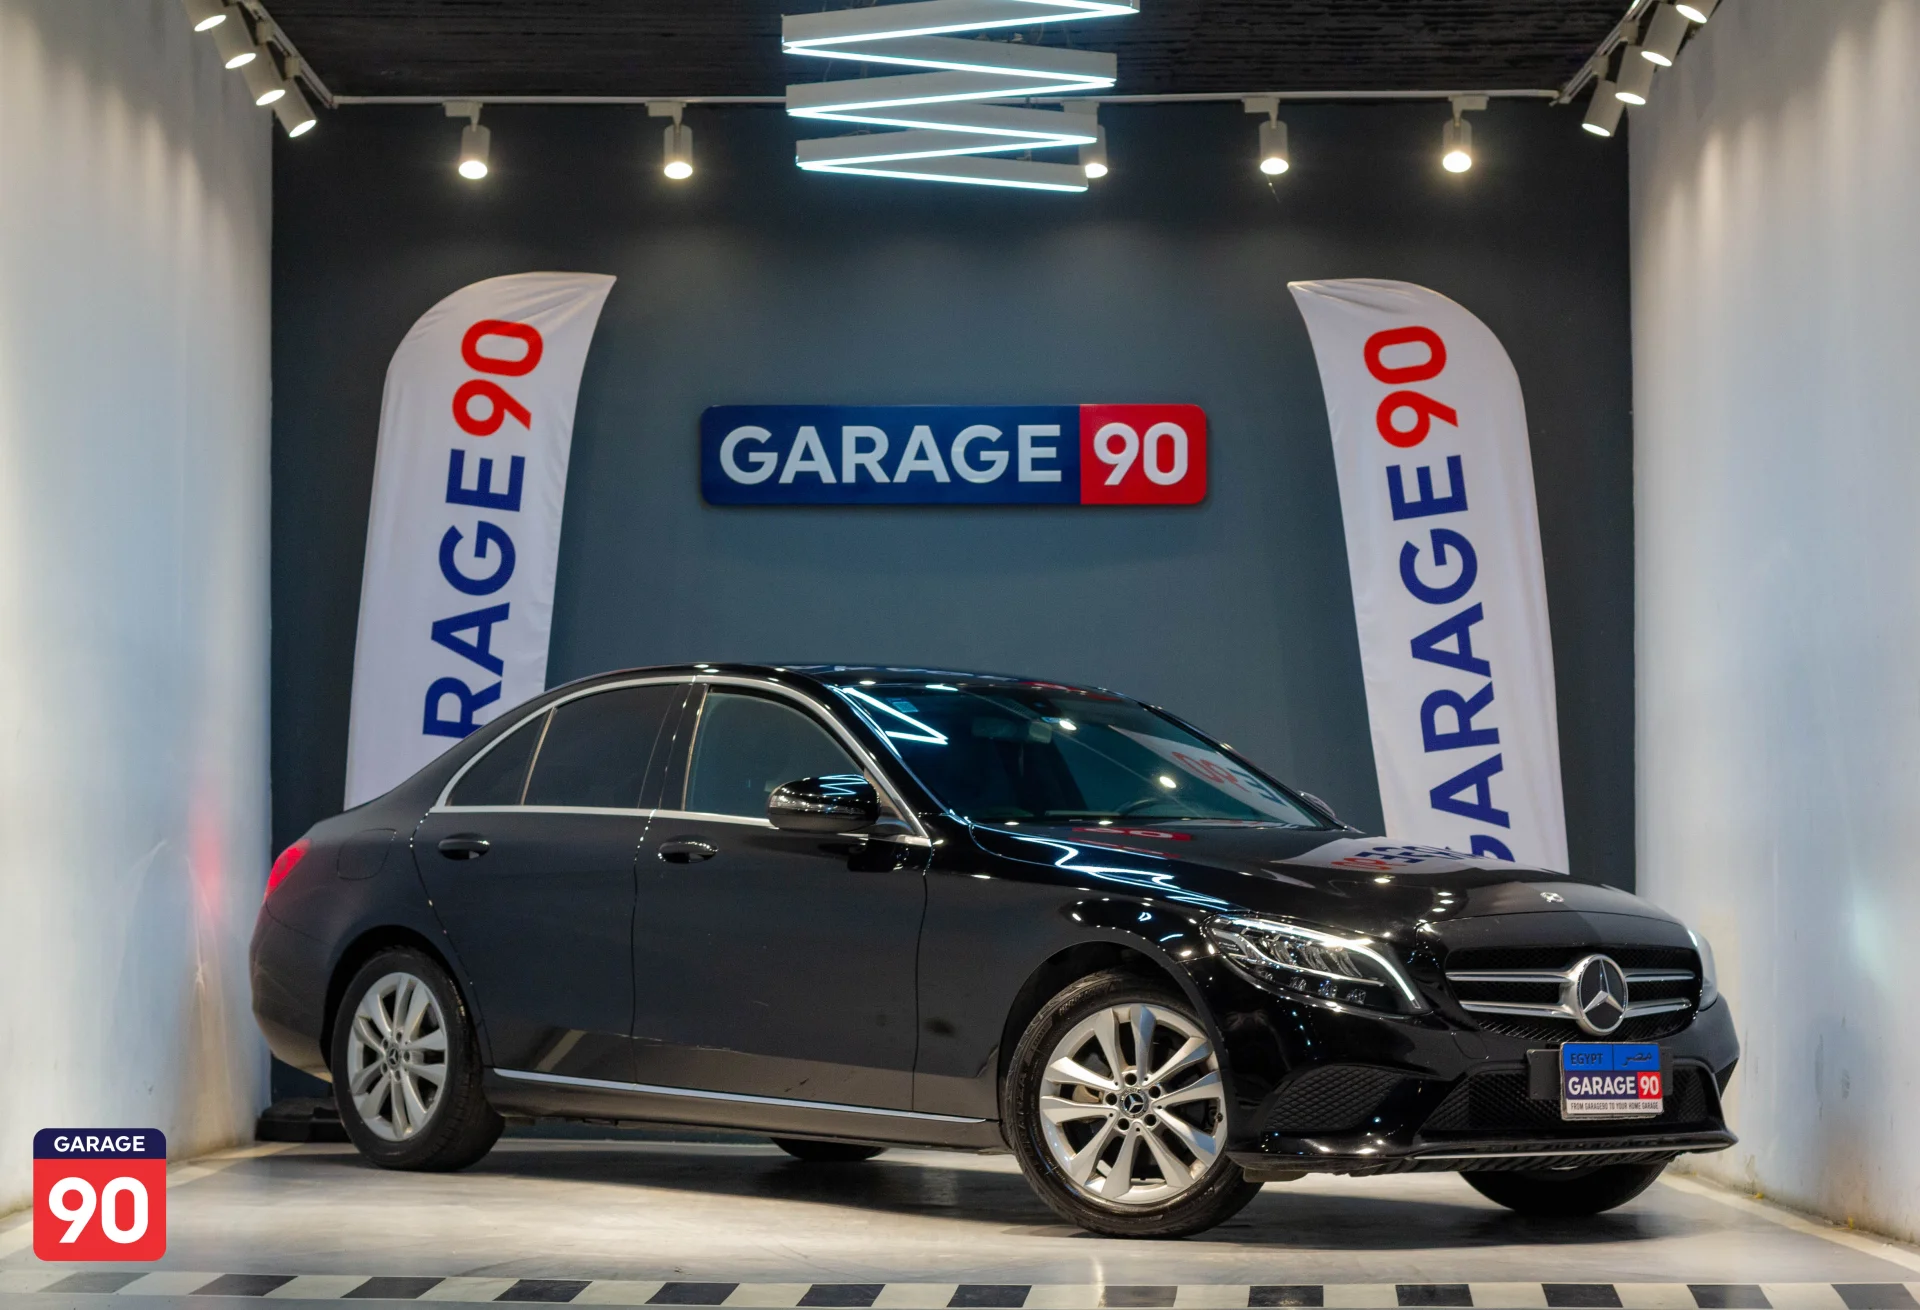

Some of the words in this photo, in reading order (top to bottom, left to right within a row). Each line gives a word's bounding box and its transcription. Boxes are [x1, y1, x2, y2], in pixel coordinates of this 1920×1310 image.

[719, 424, 1063, 485] GARAGE
[1093, 421, 1189, 487] 90
[1570, 1053, 1603, 1066] EGYPT
[1568, 1076, 1637, 1096] GARAGE
[1640, 1075, 1660, 1096] 90
[1570, 1102, 1584, 1110] FROM
[1609, 1102, 1615, 1110] TO
[1616, 1102, 1628, 1110] YOUR
[1629, 1102, 1641, 1110] HOME
[1642, 1101, 1659, 1110] GARAGE
